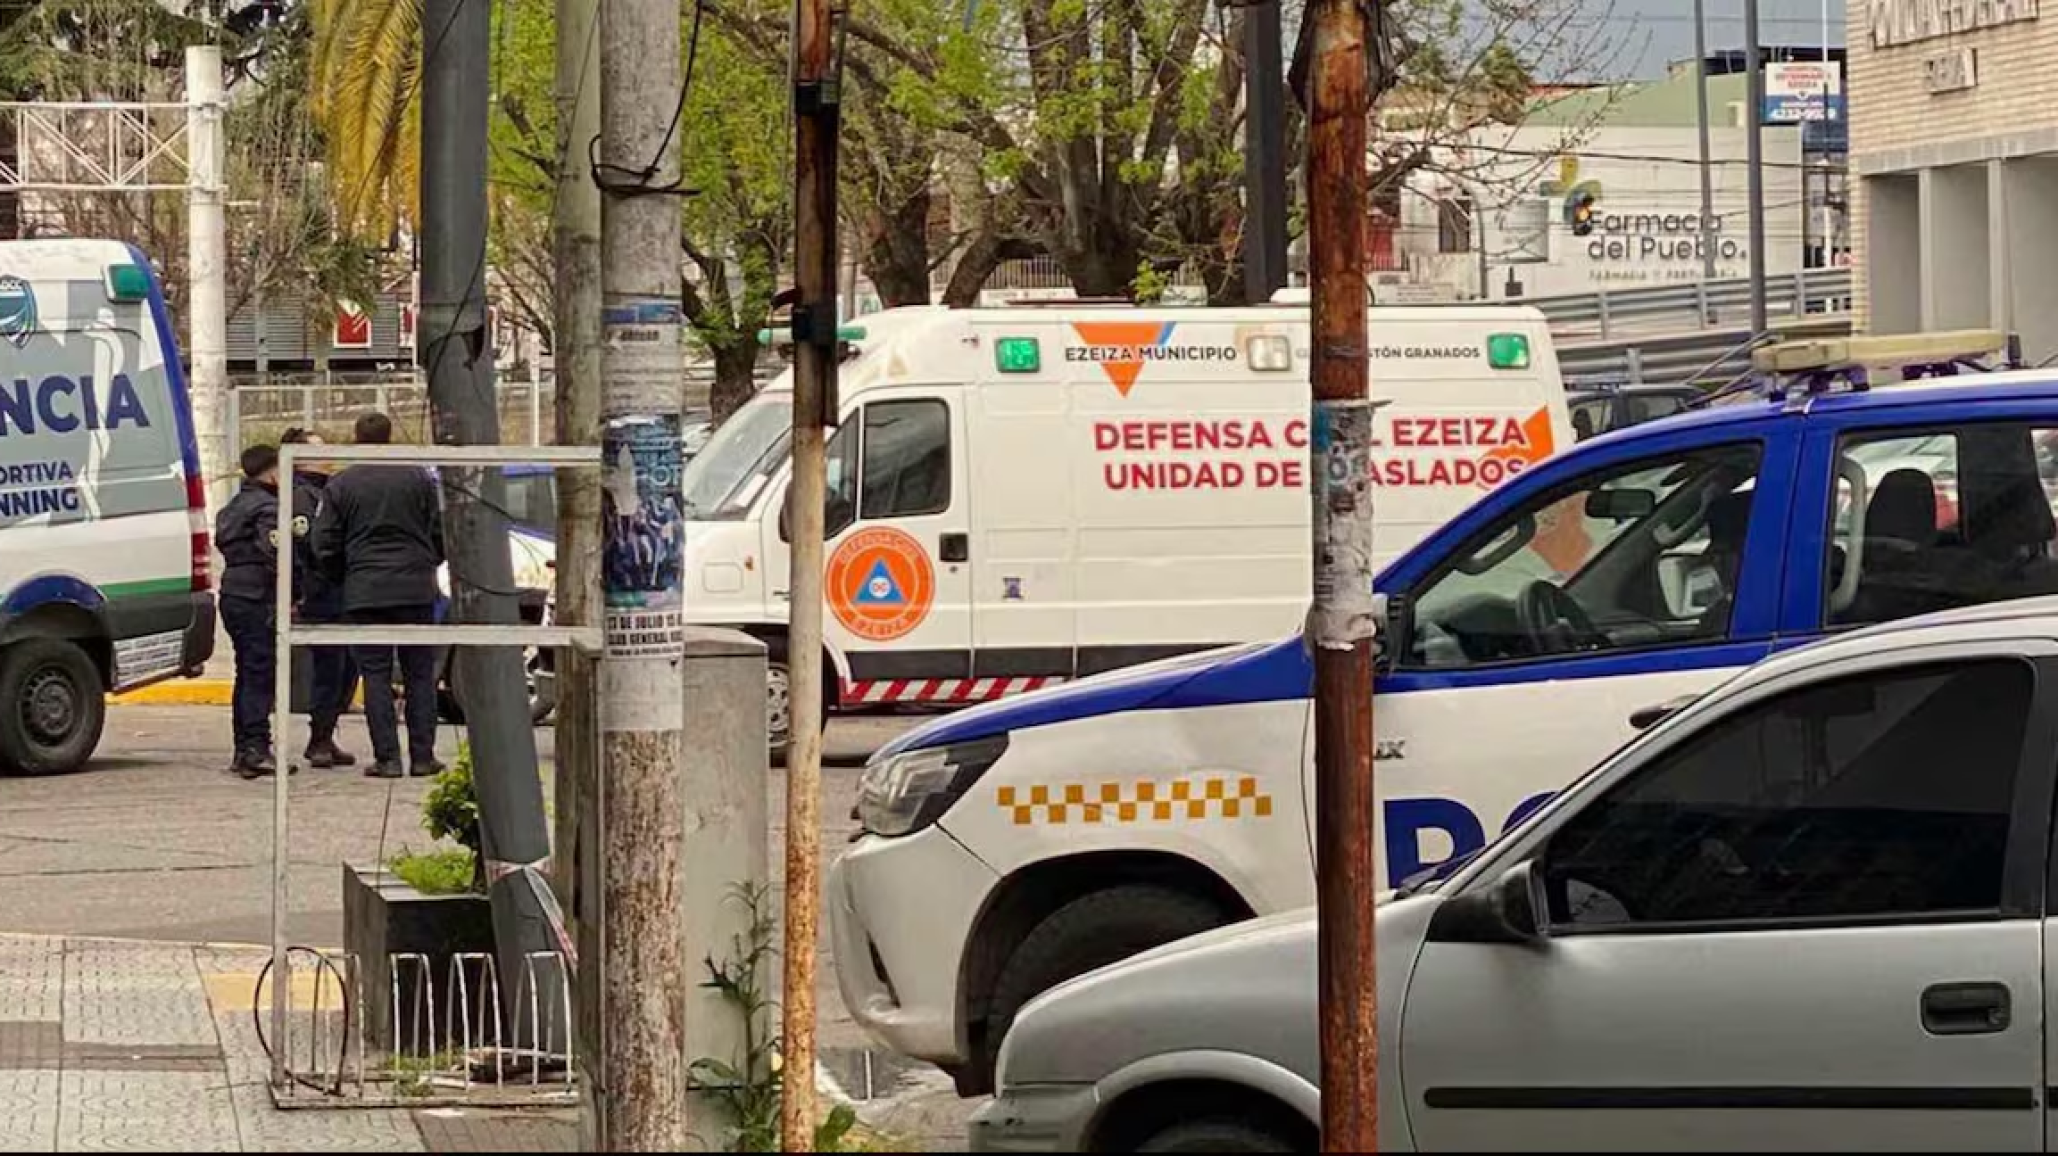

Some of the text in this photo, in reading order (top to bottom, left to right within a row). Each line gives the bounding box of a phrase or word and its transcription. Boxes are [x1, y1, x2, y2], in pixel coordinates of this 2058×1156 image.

[1587, 234, 1631, 260] del
[1065, 347, 1237, 362] EZEIZA MUNICIPIO
[1404, 347, 1481, 358] GRANADOS
[1094, 420, 1273, 450] DEFENSA
[1393, 417, 1526, 446] EZEIZA
[1104, 461, 1245, 490] UNIDAD
[1255, 461, 1303, 488] DE
